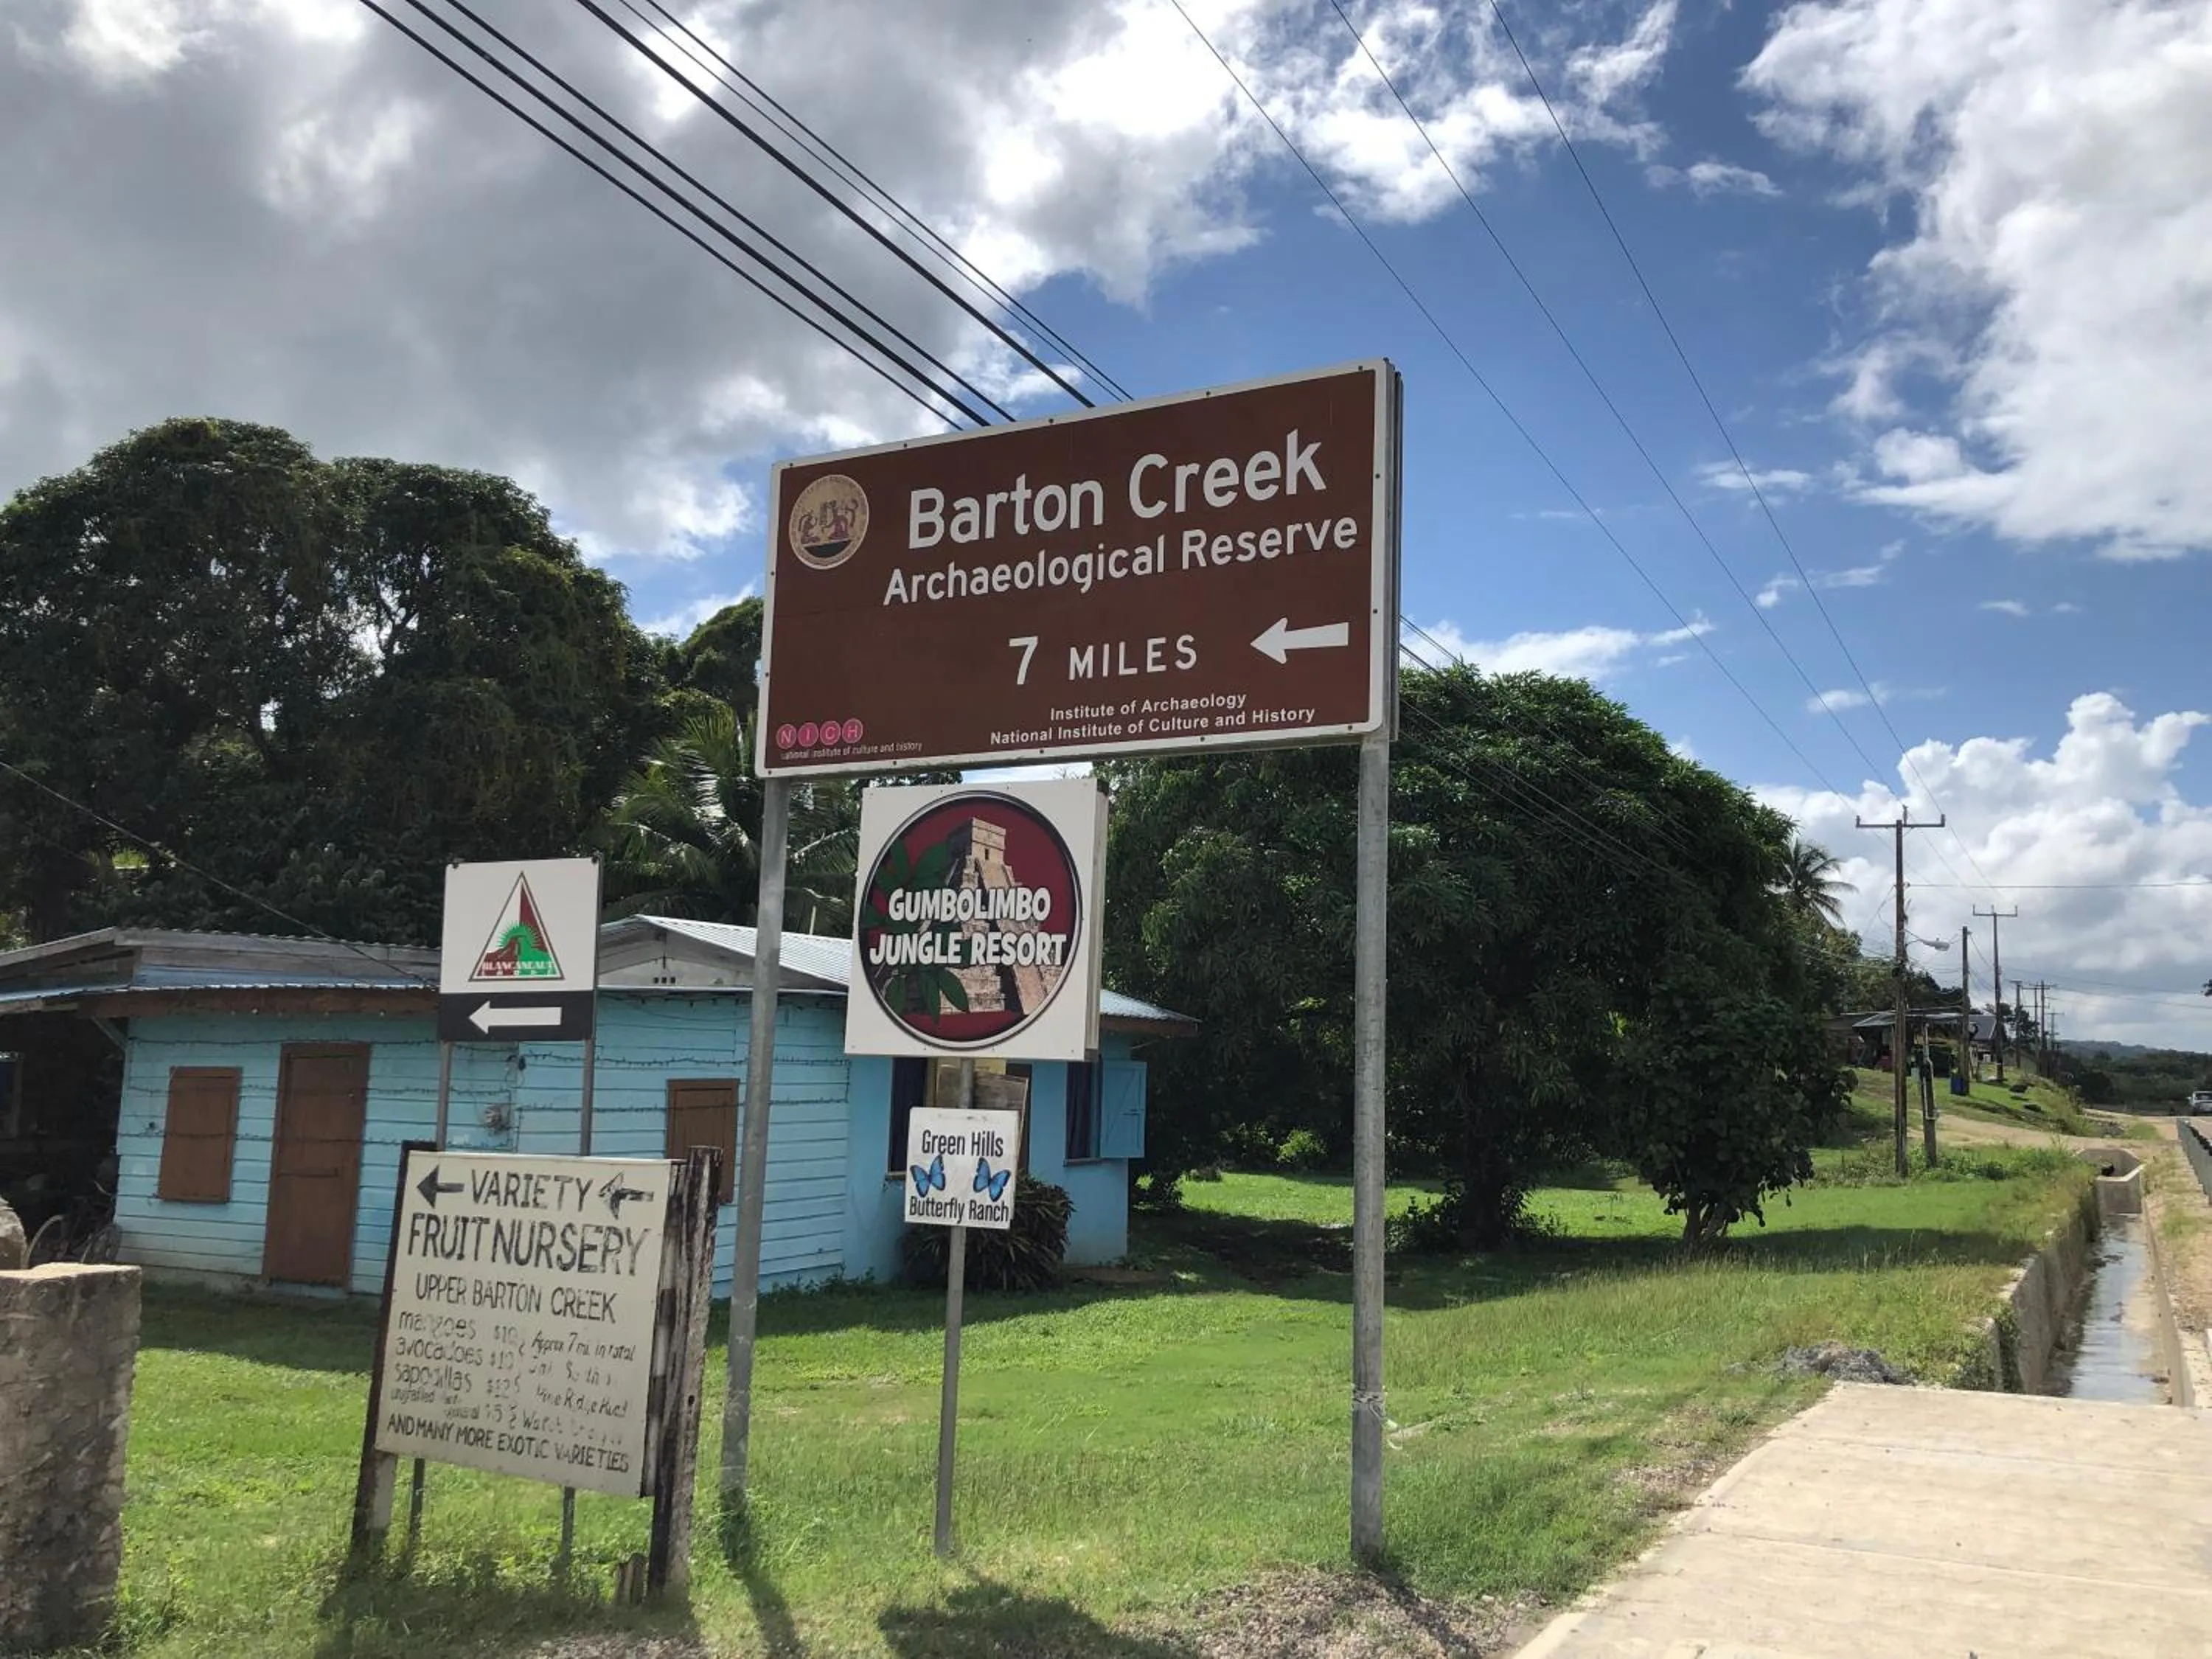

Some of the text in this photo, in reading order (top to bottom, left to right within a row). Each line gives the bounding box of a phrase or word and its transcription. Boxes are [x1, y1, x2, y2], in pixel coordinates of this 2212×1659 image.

[908, 473, 1105, 549] Barton
[1128, 429, 1327, 518] Creek
[883, 517, 1358, 605] Archaeological Reserve
[1009, 634, 1197, 686] 7 MILES
[990, 707, 1316, 745] National Institute of Culture and History
[1050, 692, 1248, 721] Institute of Archaeology
[887, 887, 1052, 922] GUMBOLIMBO
[869, 931, 1068, 967] JUNGLE RESORT
[921, 1129, 1004, 1158] Green Hills
[471, 1169, 594, 1212] VARIETY
[909, 1195, 1009, 1224] Butterfly Ranch
[407, 1212, 653, 1277] FRUIT NURSERY
[415, 1272, 619, 1324] UPPER BARTON CREEK
[386, 1413, 630, 1474] AND MANY MORE EXOTIC VARIETIES
